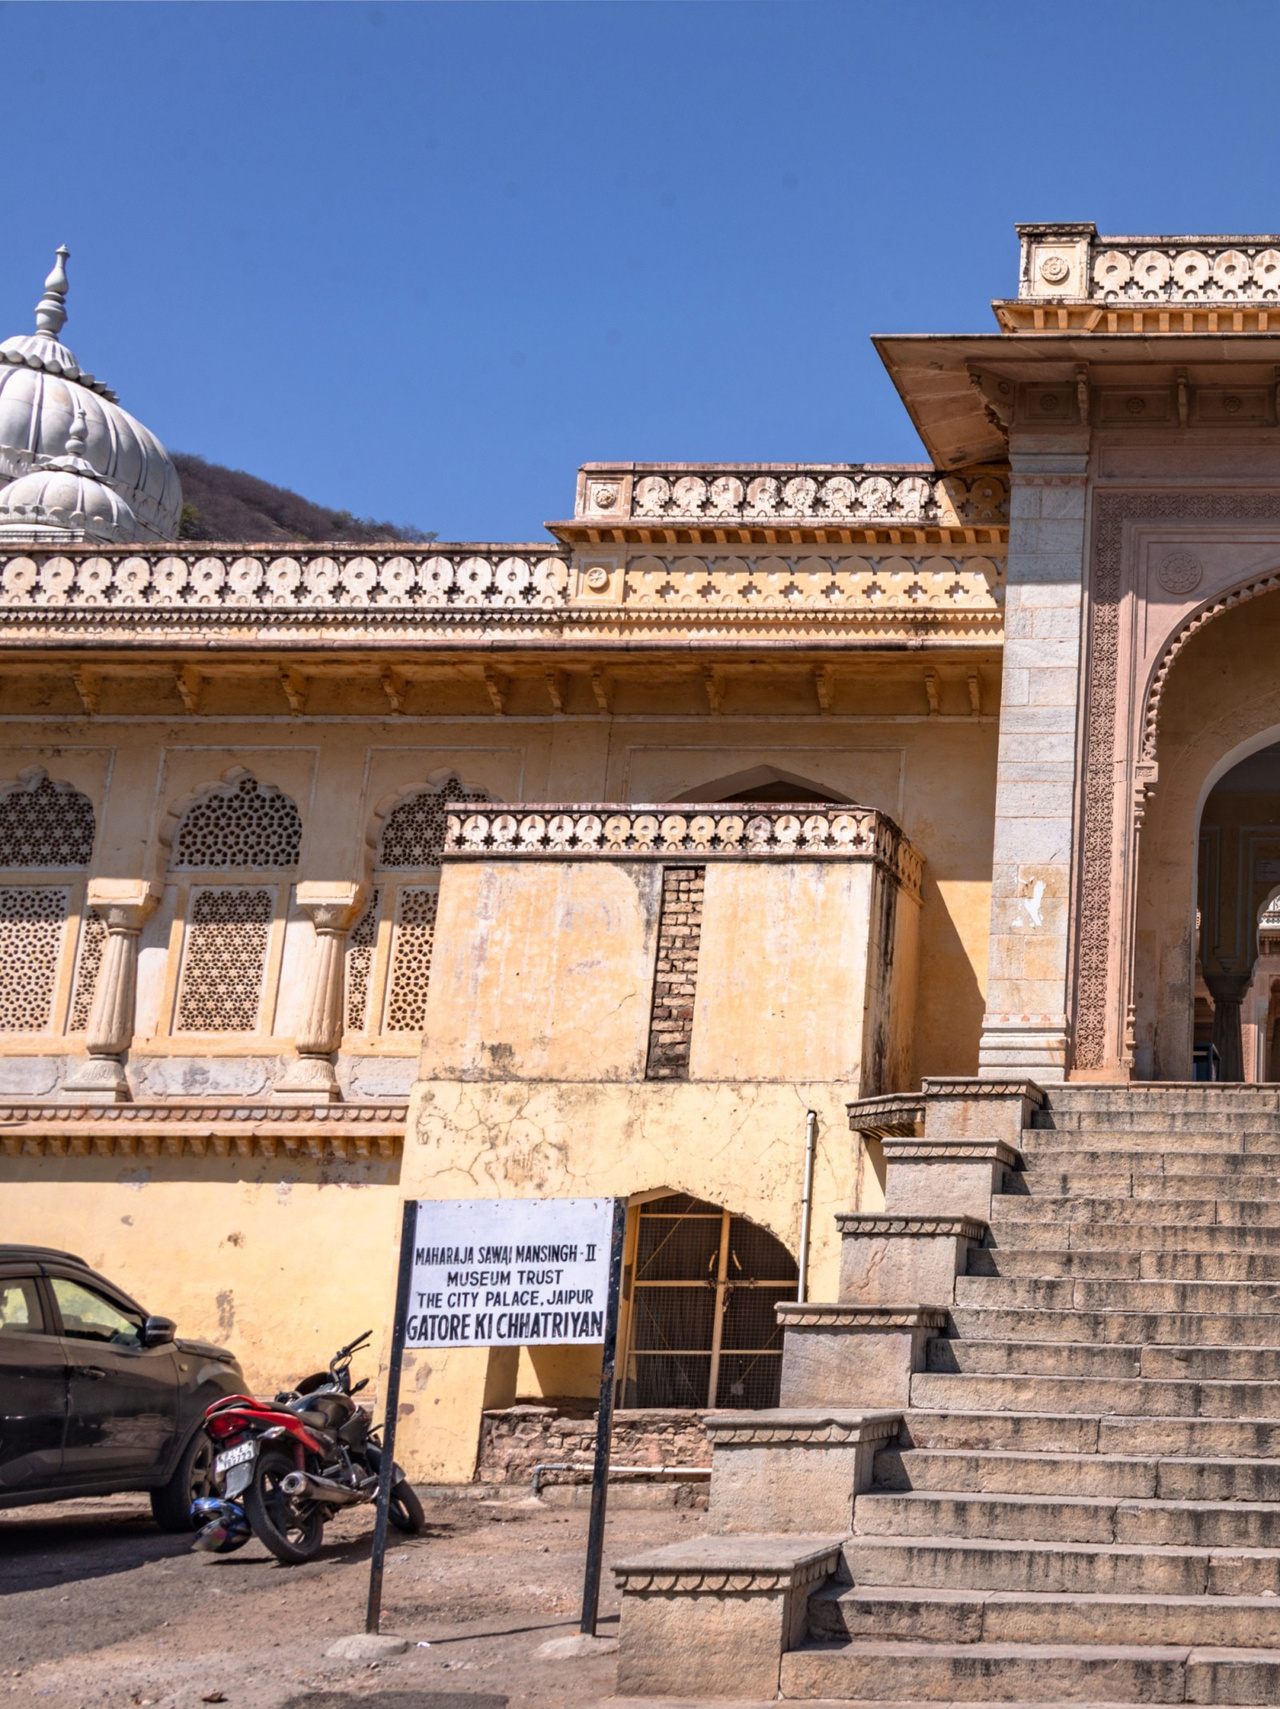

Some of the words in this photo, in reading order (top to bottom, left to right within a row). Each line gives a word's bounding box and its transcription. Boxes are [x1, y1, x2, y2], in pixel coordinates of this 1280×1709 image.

[415, 1246, 474, 1266] MAHARAJA
[477, 1246, 512, 1265] SAWAI
[447, 1271, 511, 1287] MUSEUM
[517, 1269, 564, 1285] TRUST
[418, 1293, 443, 1309] THE
[447, 1292, 480, 1308] CITY
[485, 1291, 544, 1307] PALACE,
[547, 1289, 594, 1305] JAIPUR
[407, 1313, 471, 1341] GATORE
[474, 1313, 493, 1340] KI
[496, 1311, 604, 1338] CHHATRIYAN
